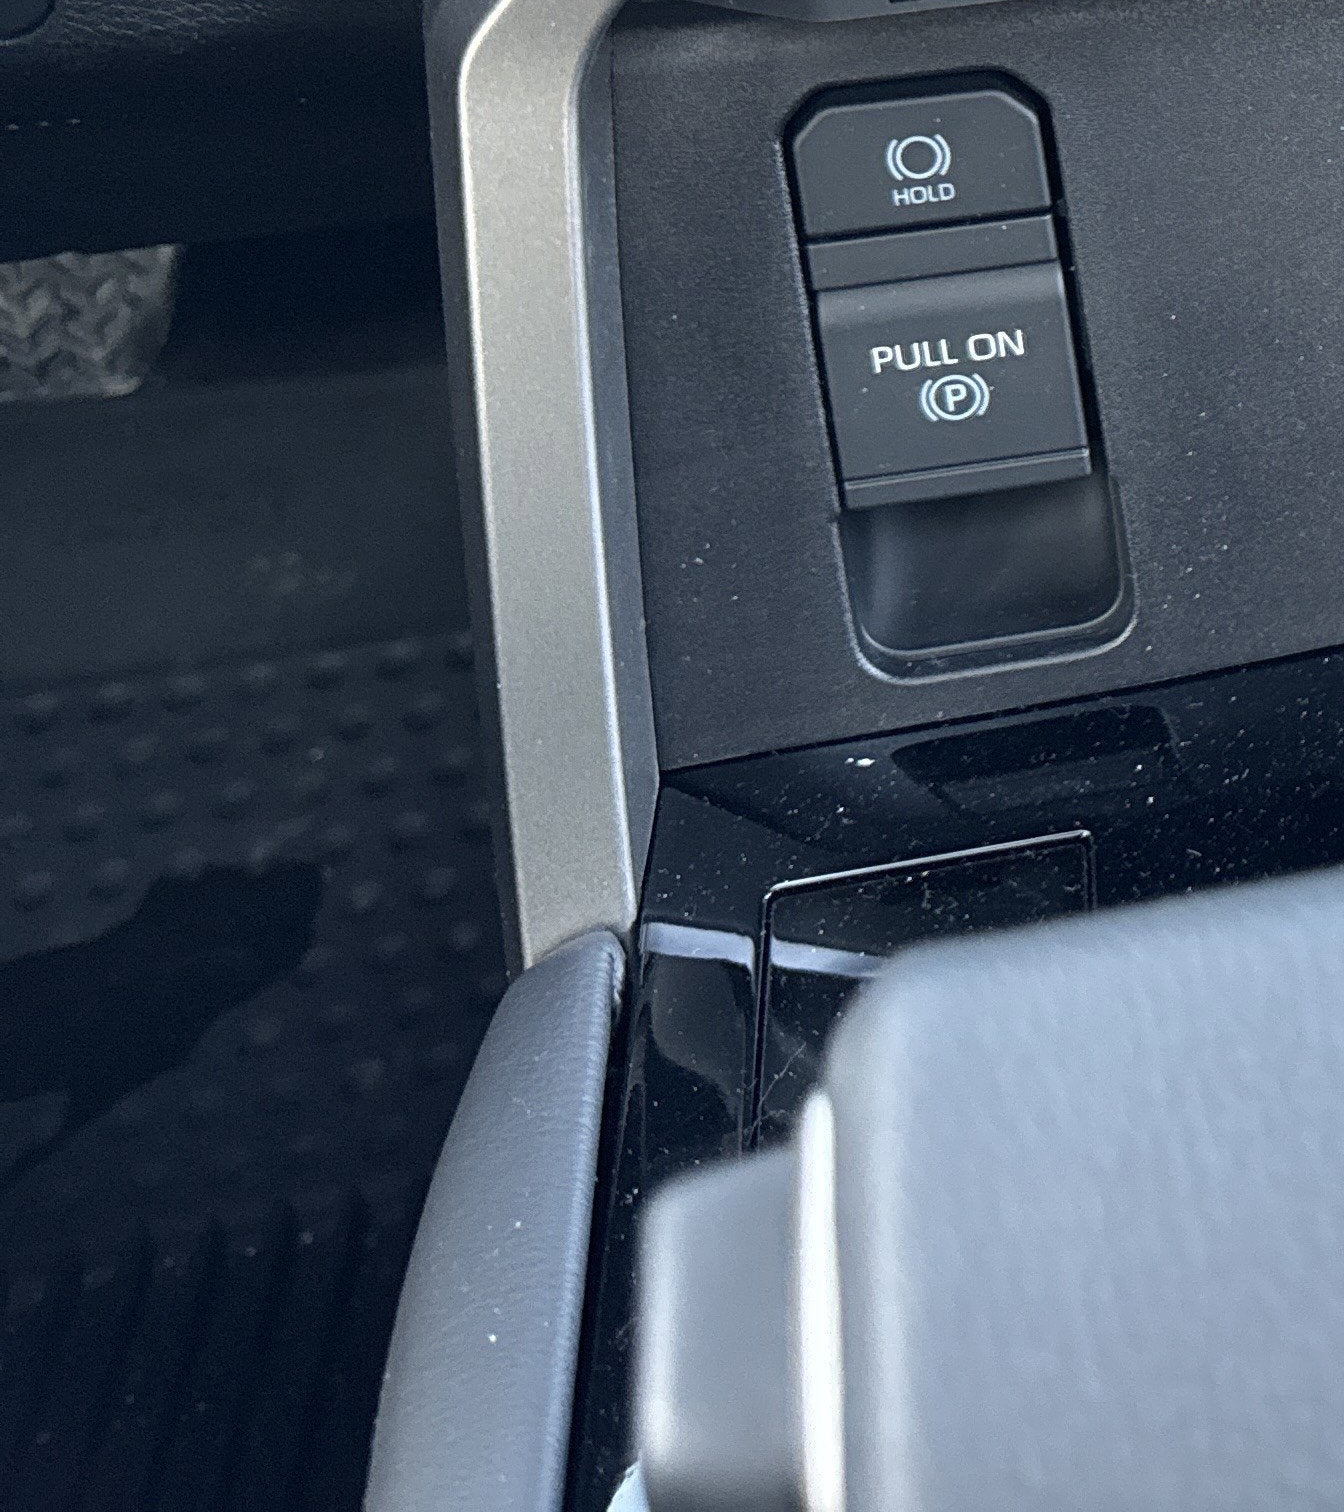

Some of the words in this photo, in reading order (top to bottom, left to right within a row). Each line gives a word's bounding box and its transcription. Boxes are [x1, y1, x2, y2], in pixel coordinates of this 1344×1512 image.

[893, 183, 955, 206] HOLD
[871, 339, 959, 374] PULL
[967, 330, 1025, 362] ON
